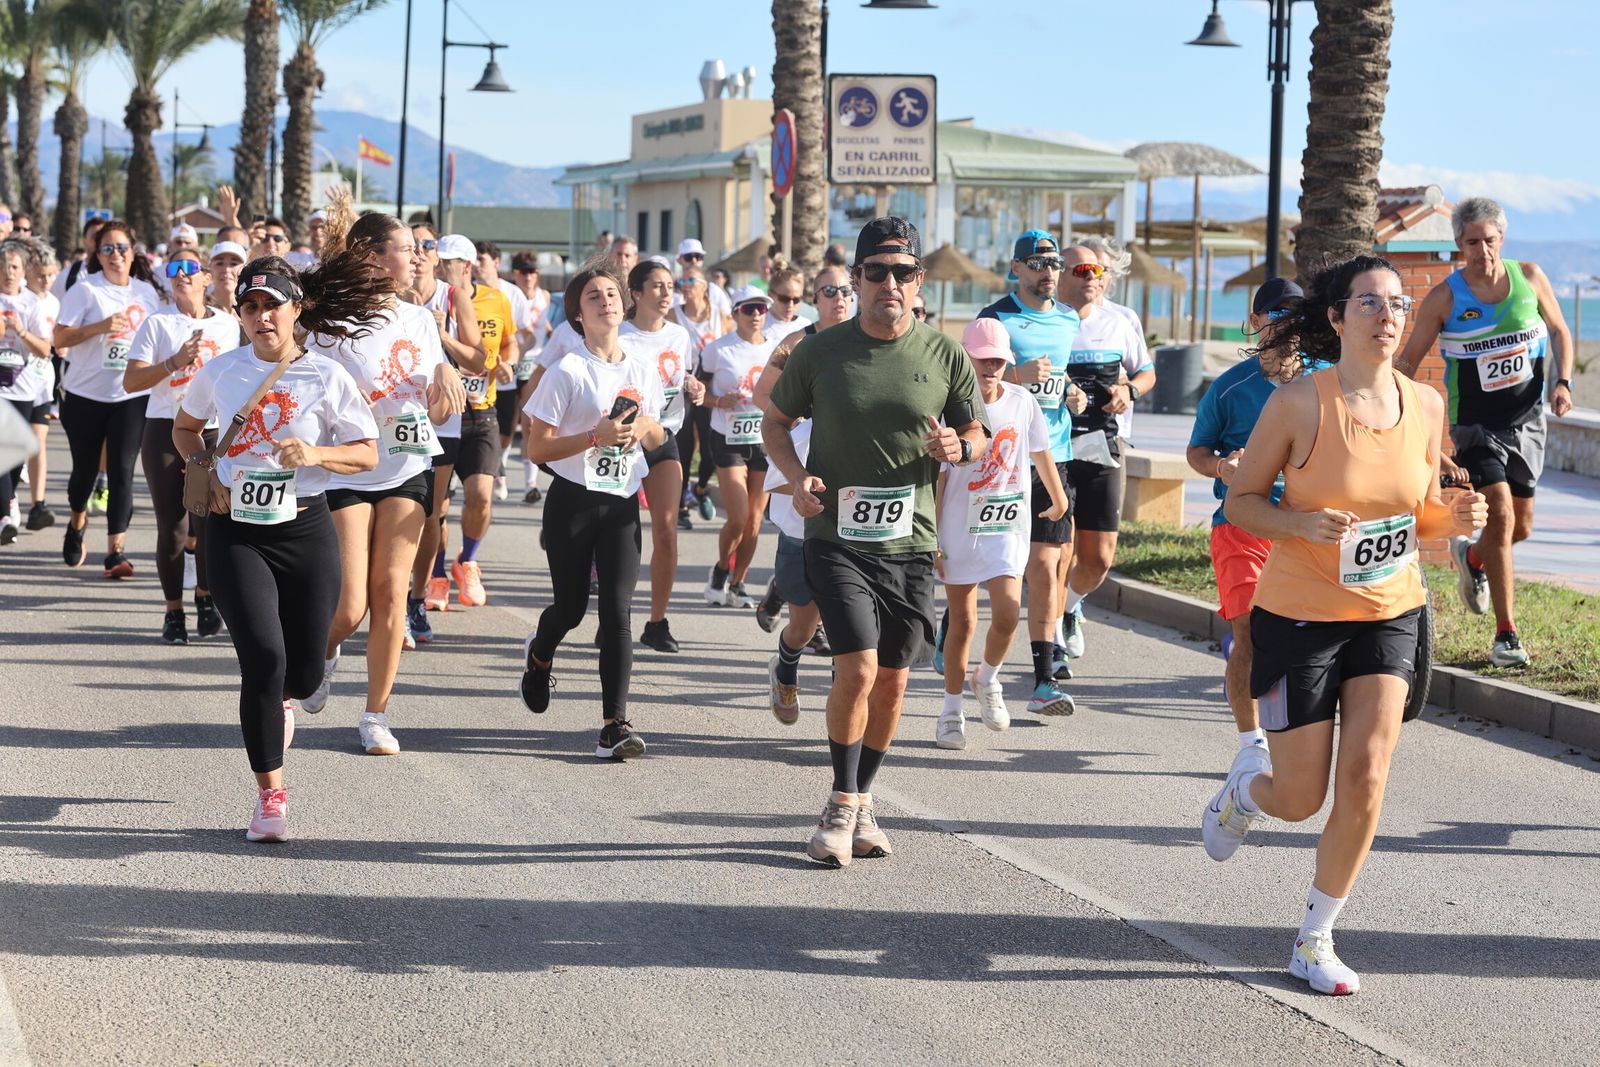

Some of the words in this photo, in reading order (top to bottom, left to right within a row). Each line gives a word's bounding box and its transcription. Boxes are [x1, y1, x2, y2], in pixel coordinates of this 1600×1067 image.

[836, 136, 880, 145] BICICLETAS
[893, 137, 925, 145] PATINES
[844, 151, 864, 161] EN
[869, 151, 922, 162] CARRIL
[837, 164, 930, 176] SEÑALIZADO
[1462, 327, 1539, 353] TORREMOLINOS
[1487, 355, 1524, 379] 260
[395, 422, 431, 444] 615
[732, 419, 761, 435] 509
[595, 456, 628, 477] 818
[240, 481, 287, 507] 801
[852, 500, 904, 524] 819
[979, 503, 1019, 522] 616
[1354, 529, 1408, 566] 693
